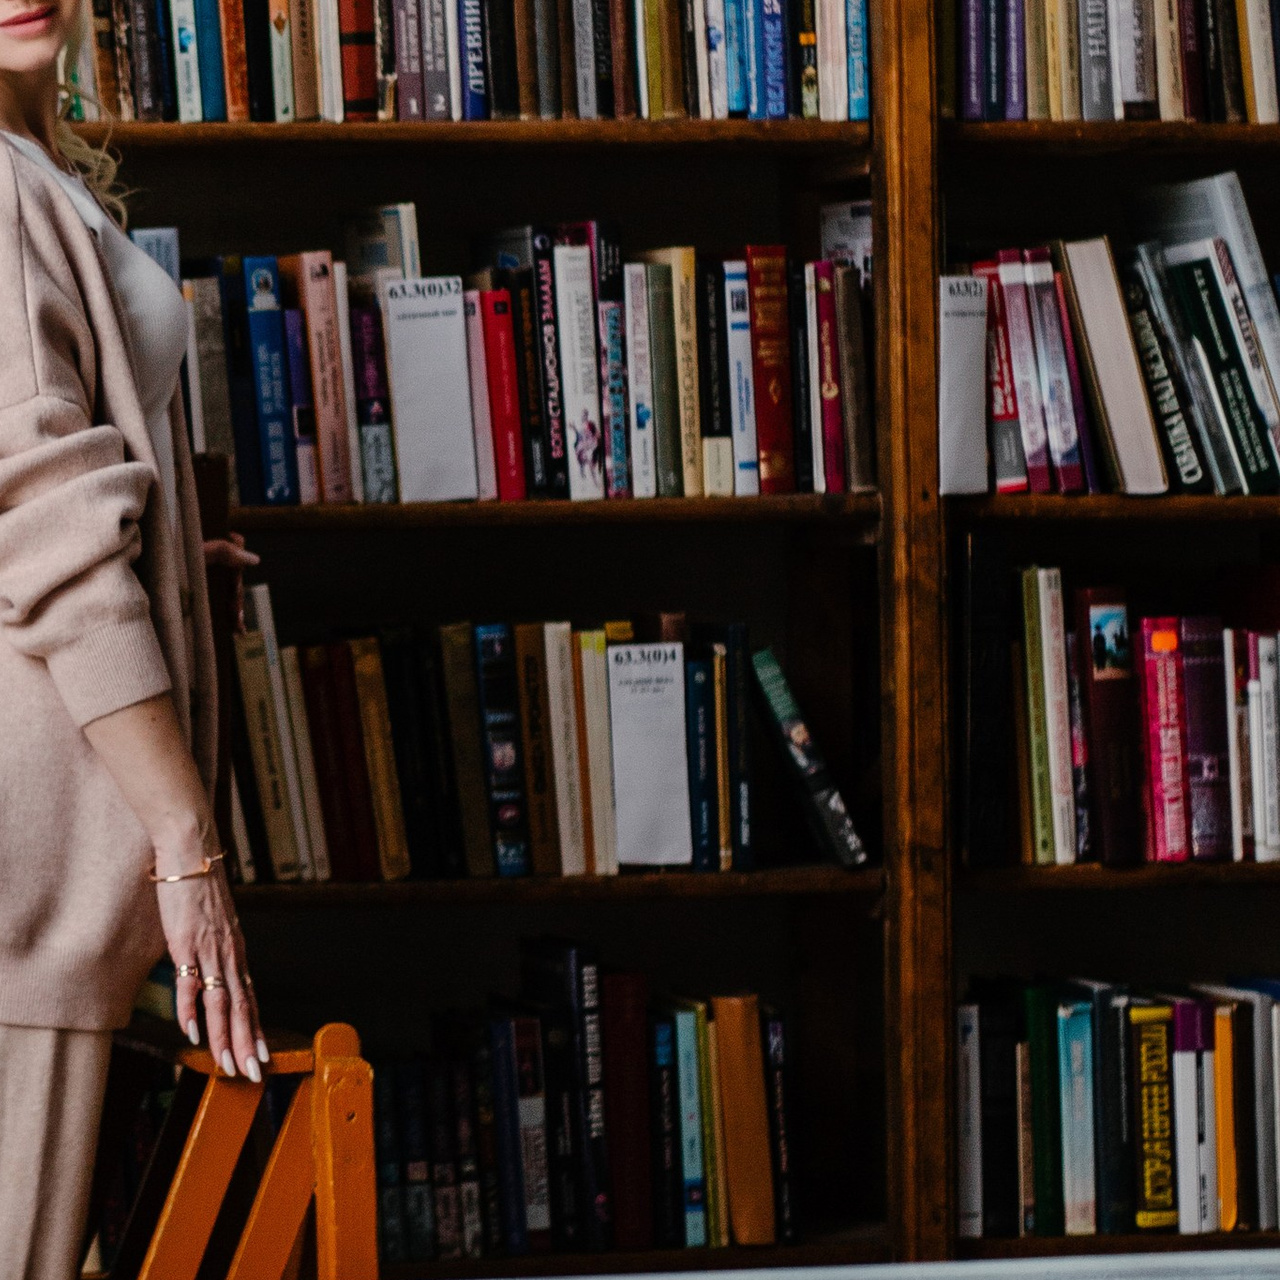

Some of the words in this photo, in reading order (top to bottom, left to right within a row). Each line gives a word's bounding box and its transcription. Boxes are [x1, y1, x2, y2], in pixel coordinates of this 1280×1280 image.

[765, 19, 785, 116] ВЕЛИКИЕ
[387, 279, 463, 300] 63.3(0)32
[537, 258, 555, 320] ЭЛЛАДЫ
[543, 323, 561, 417] СТАДИОНОВ
[615, 647, 676, 664] 63.3(0)4
